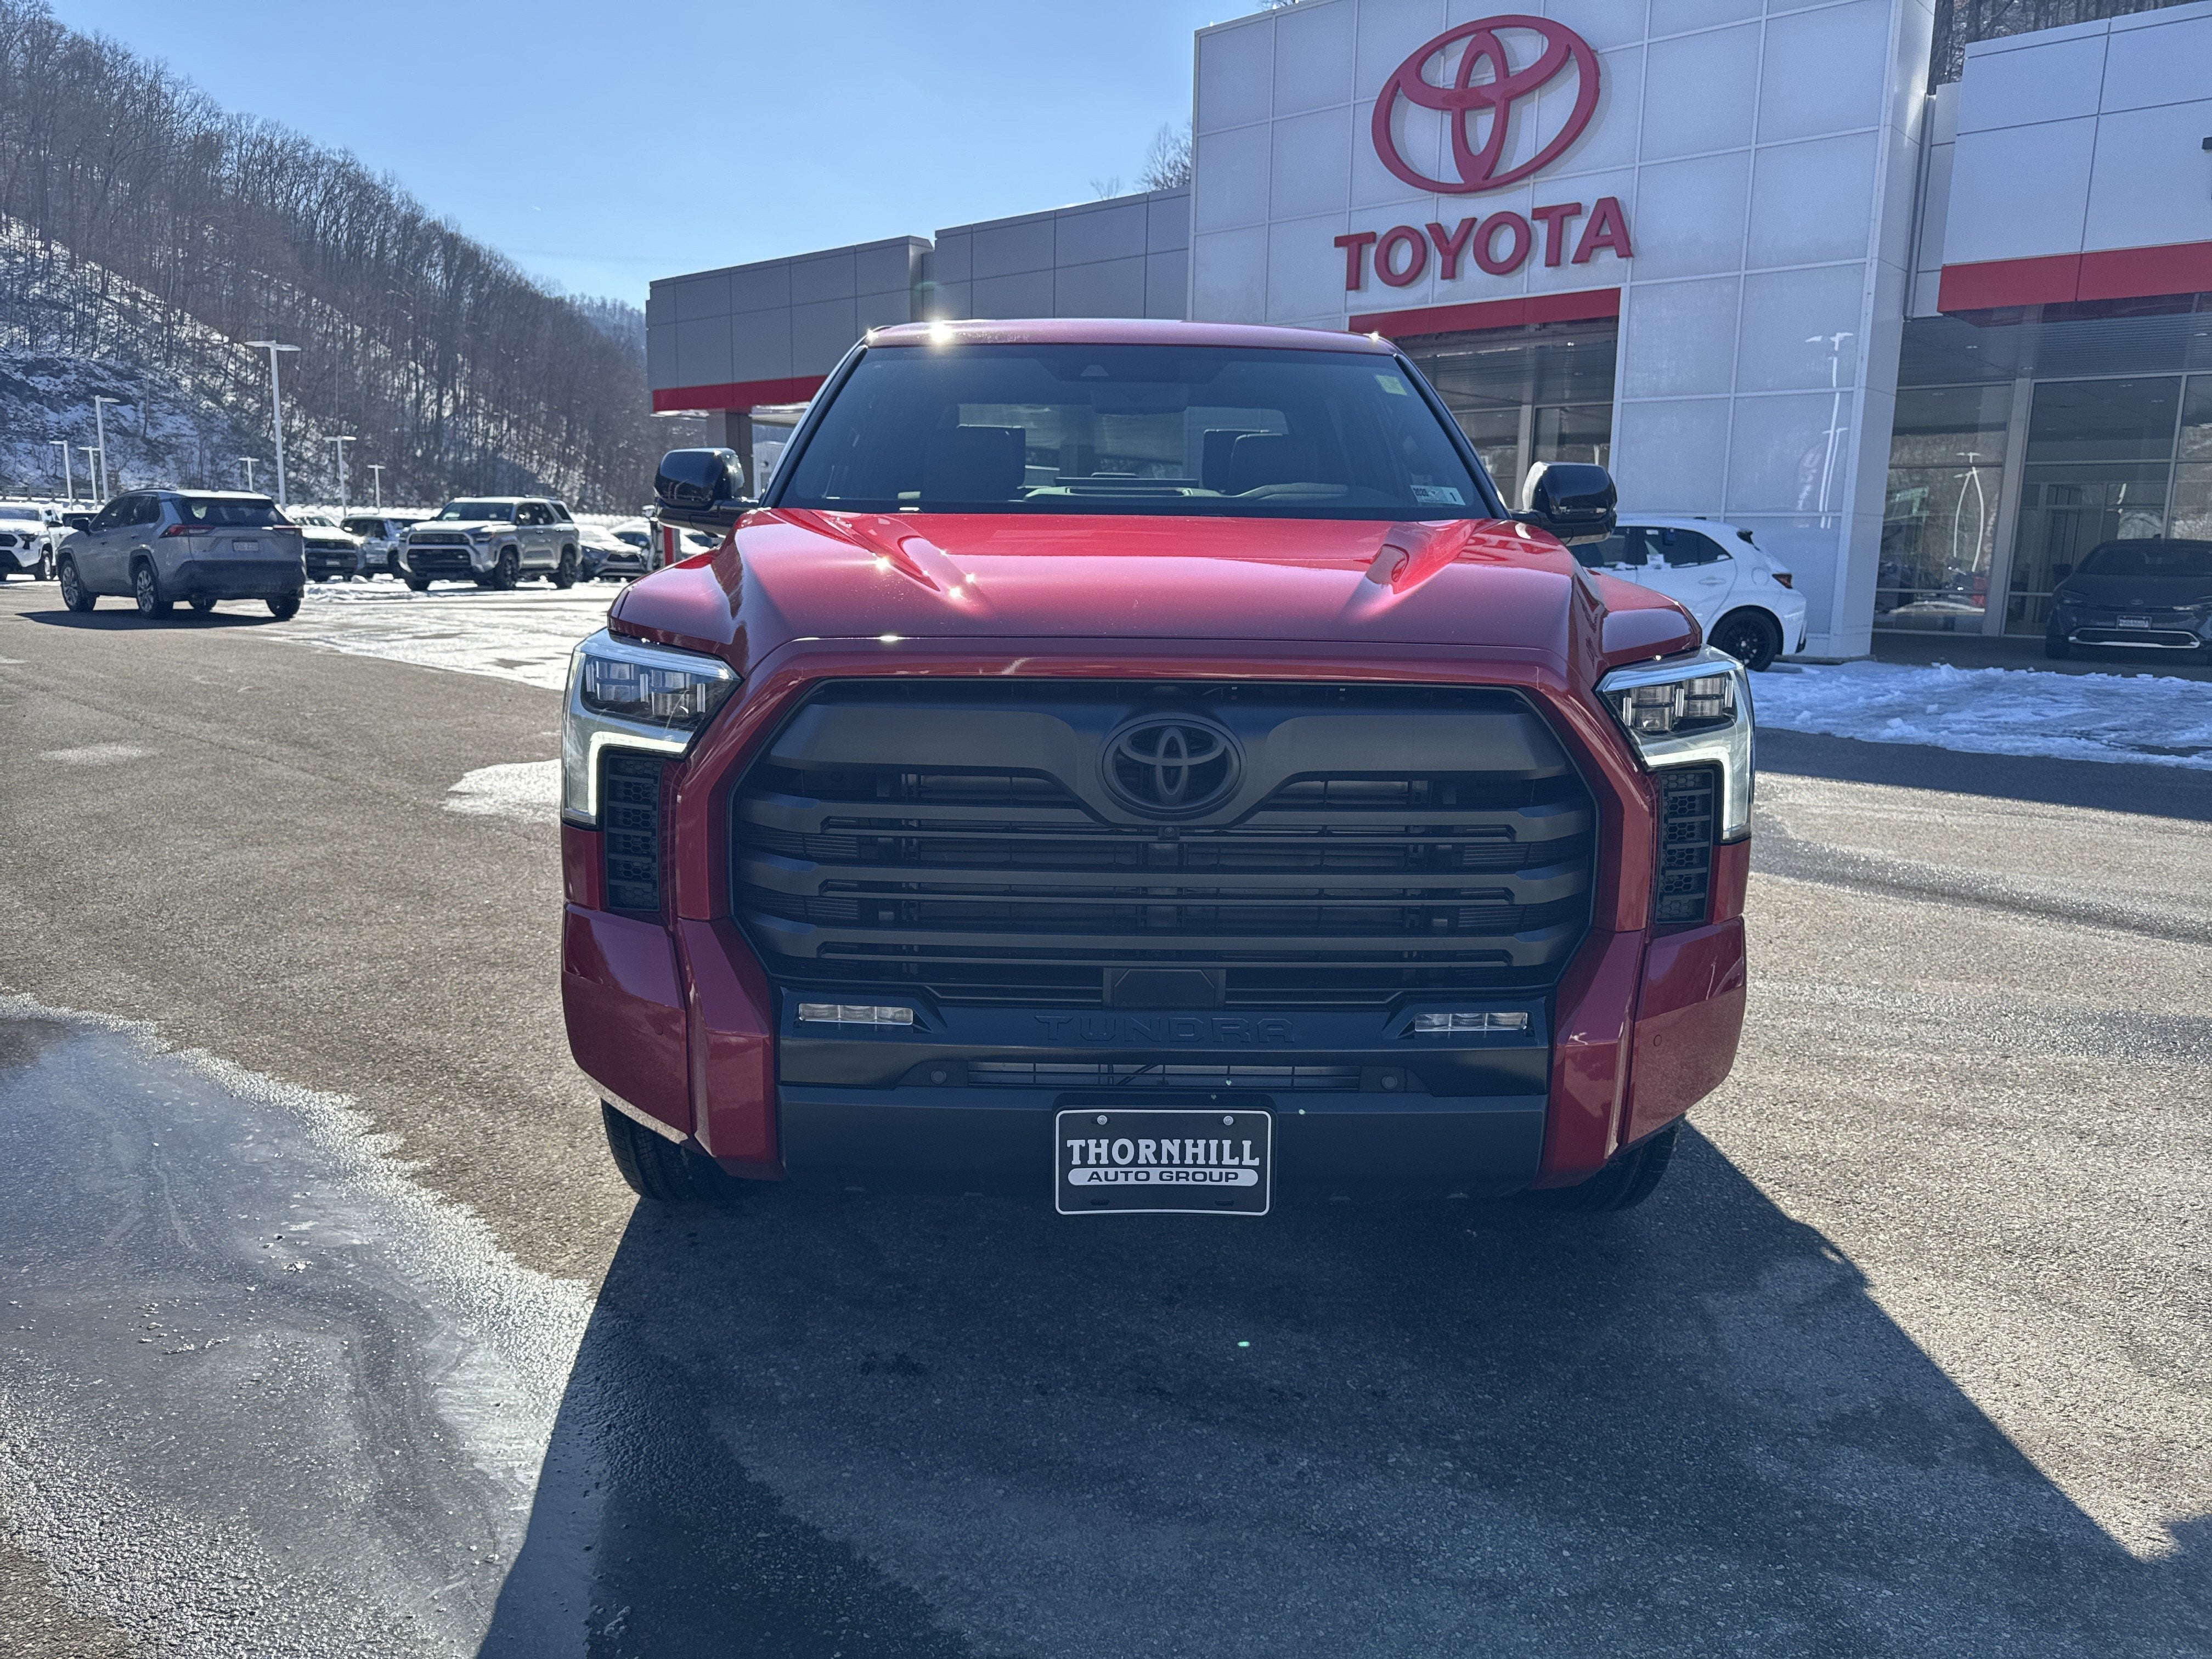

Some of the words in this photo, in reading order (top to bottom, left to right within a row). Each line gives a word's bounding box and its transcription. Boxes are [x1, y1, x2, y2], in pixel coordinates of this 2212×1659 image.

[1334, 196, 1634, 291] TOYOTA
[1034, 1015, 1295, 1043] TUNDRA
[1066, 1138, 1260, 1166] THORNHILL
[1087, 1170, 1151, 1183] AUTO
[1159, 1170, 1239, 1183] GROUP
